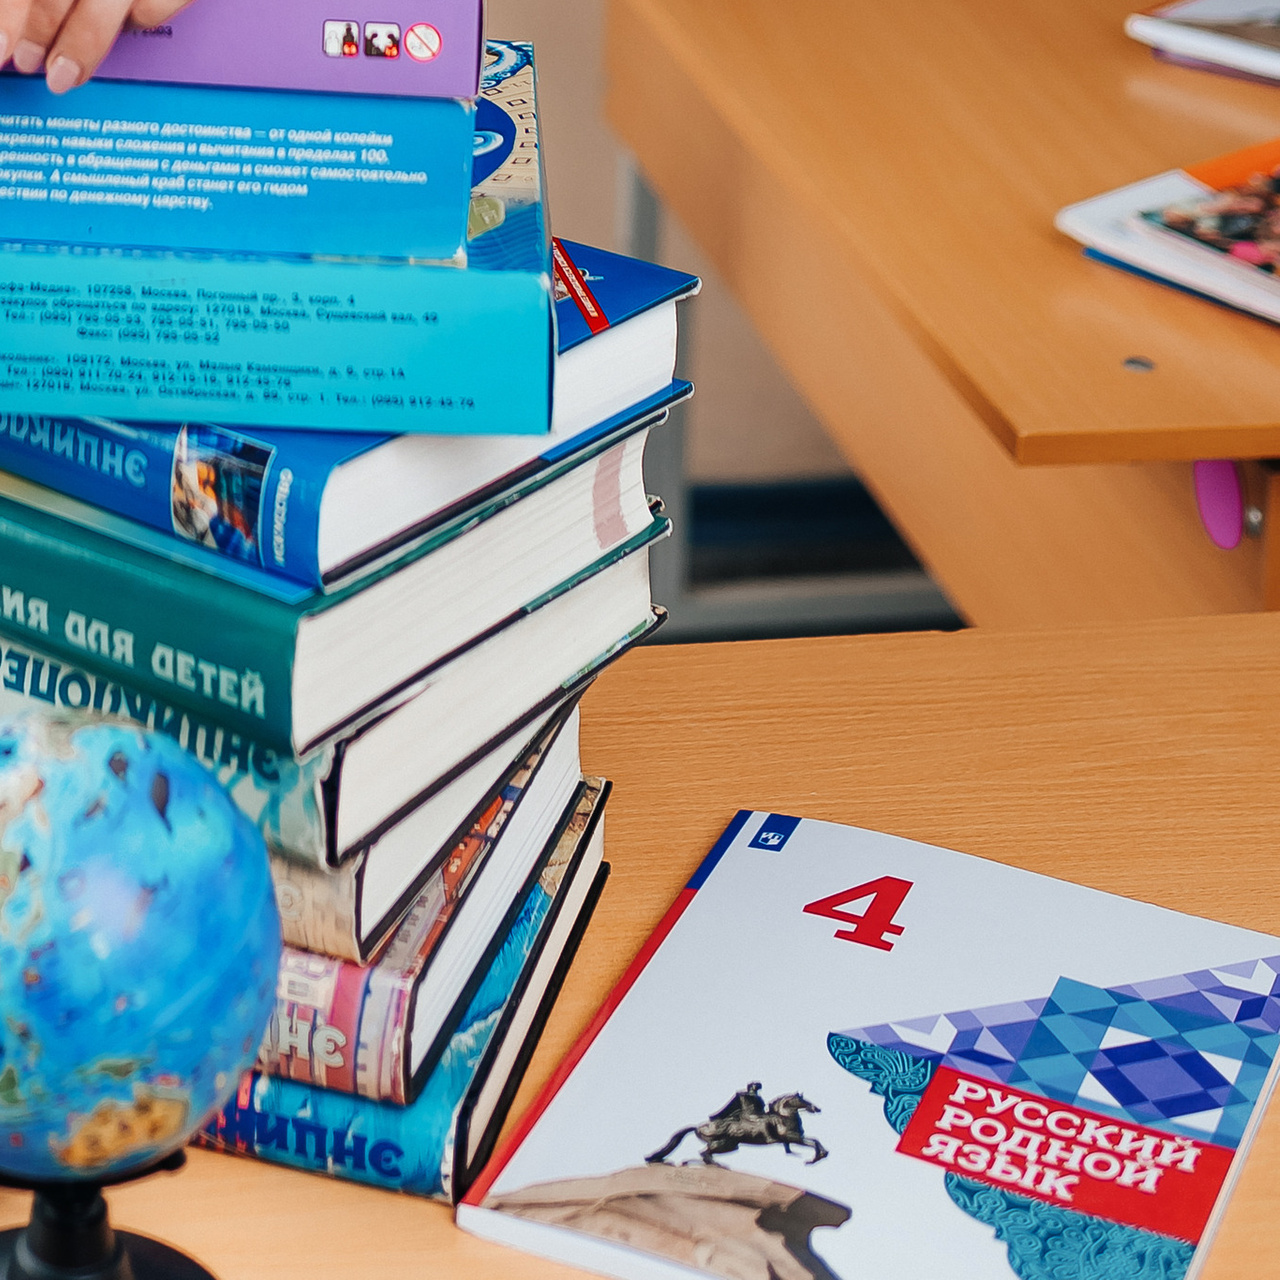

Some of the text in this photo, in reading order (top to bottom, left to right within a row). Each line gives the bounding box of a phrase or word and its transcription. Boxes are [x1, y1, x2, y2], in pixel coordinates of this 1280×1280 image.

[46, 116, 100, 130] монеты
[102, 118, 159, 135] разного
[161, 121, 251, 139] достоинства
[287, 127, 332, 143] одной
[334, 130, 393, 144] копейки
[61, 134, 113, 148] навыки
[115, 137, 185, 152] сложения
[199, 141, 274, 156] вычитания
[288, 146, 356, 162] пределах
[361, 147, 388, 162] 100.
[77, 153, 158, 170] обращении
[171, 158, 240, 175] деньгами
[254, 162, 307, 176] сможет
[310, 165, 427, 182] самостоятельно
[62, 170, 150, 186] смышленый
[151, 175, 185, 190] краб
[187, 177, 234, 190] станет
[263, 181, 308, 196] гидом
[69, 188, 149, 209] денежному
[152, 193, 213, 210] царству.
[0, 295, 47, 308] закупок
[52, 298, 127, 311] обращаться
[64, 611, 135, 665] ДЛЯ
[151, 642, 266, 717] ДЕТЕЙ
[802, 875, 914, 952] 4
[948, 1077, 1205, 1176] РУССКИЙ
[933, 1106, 1164, 1196] РОДНОЙ
[920, 1131, 1081, 1204] ЯЗЫК
